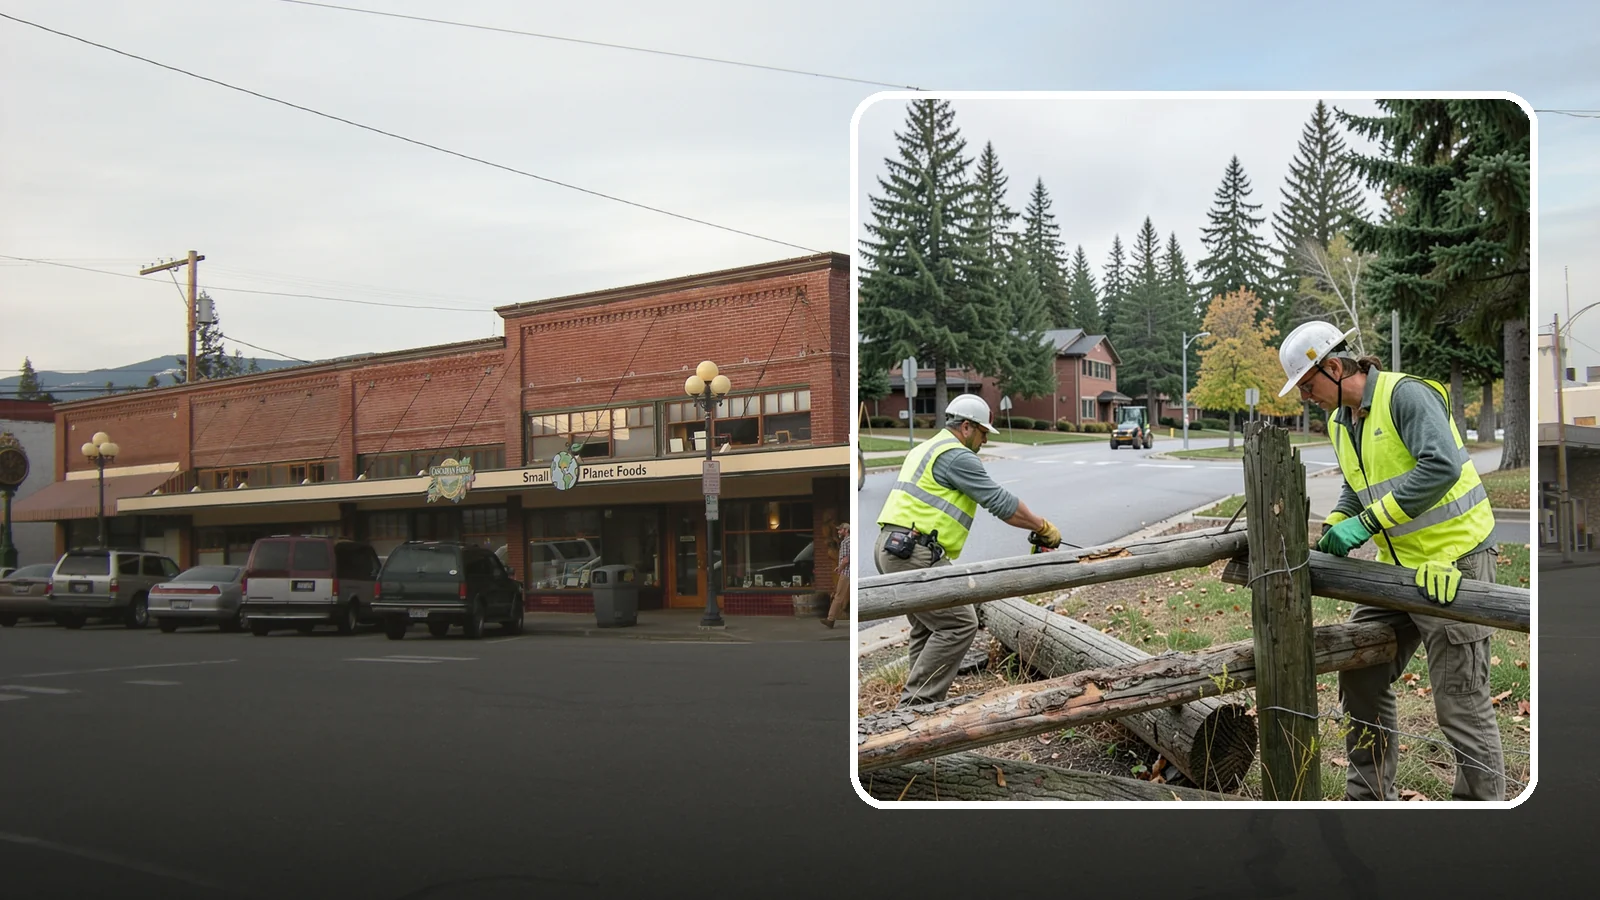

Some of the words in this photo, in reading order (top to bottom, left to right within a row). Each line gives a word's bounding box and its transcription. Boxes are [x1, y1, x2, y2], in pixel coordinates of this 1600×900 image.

[523, 470, 549, 483] Small
[583, 467, 614, 479] Planet
[617, 464, 647, 477] Foods
